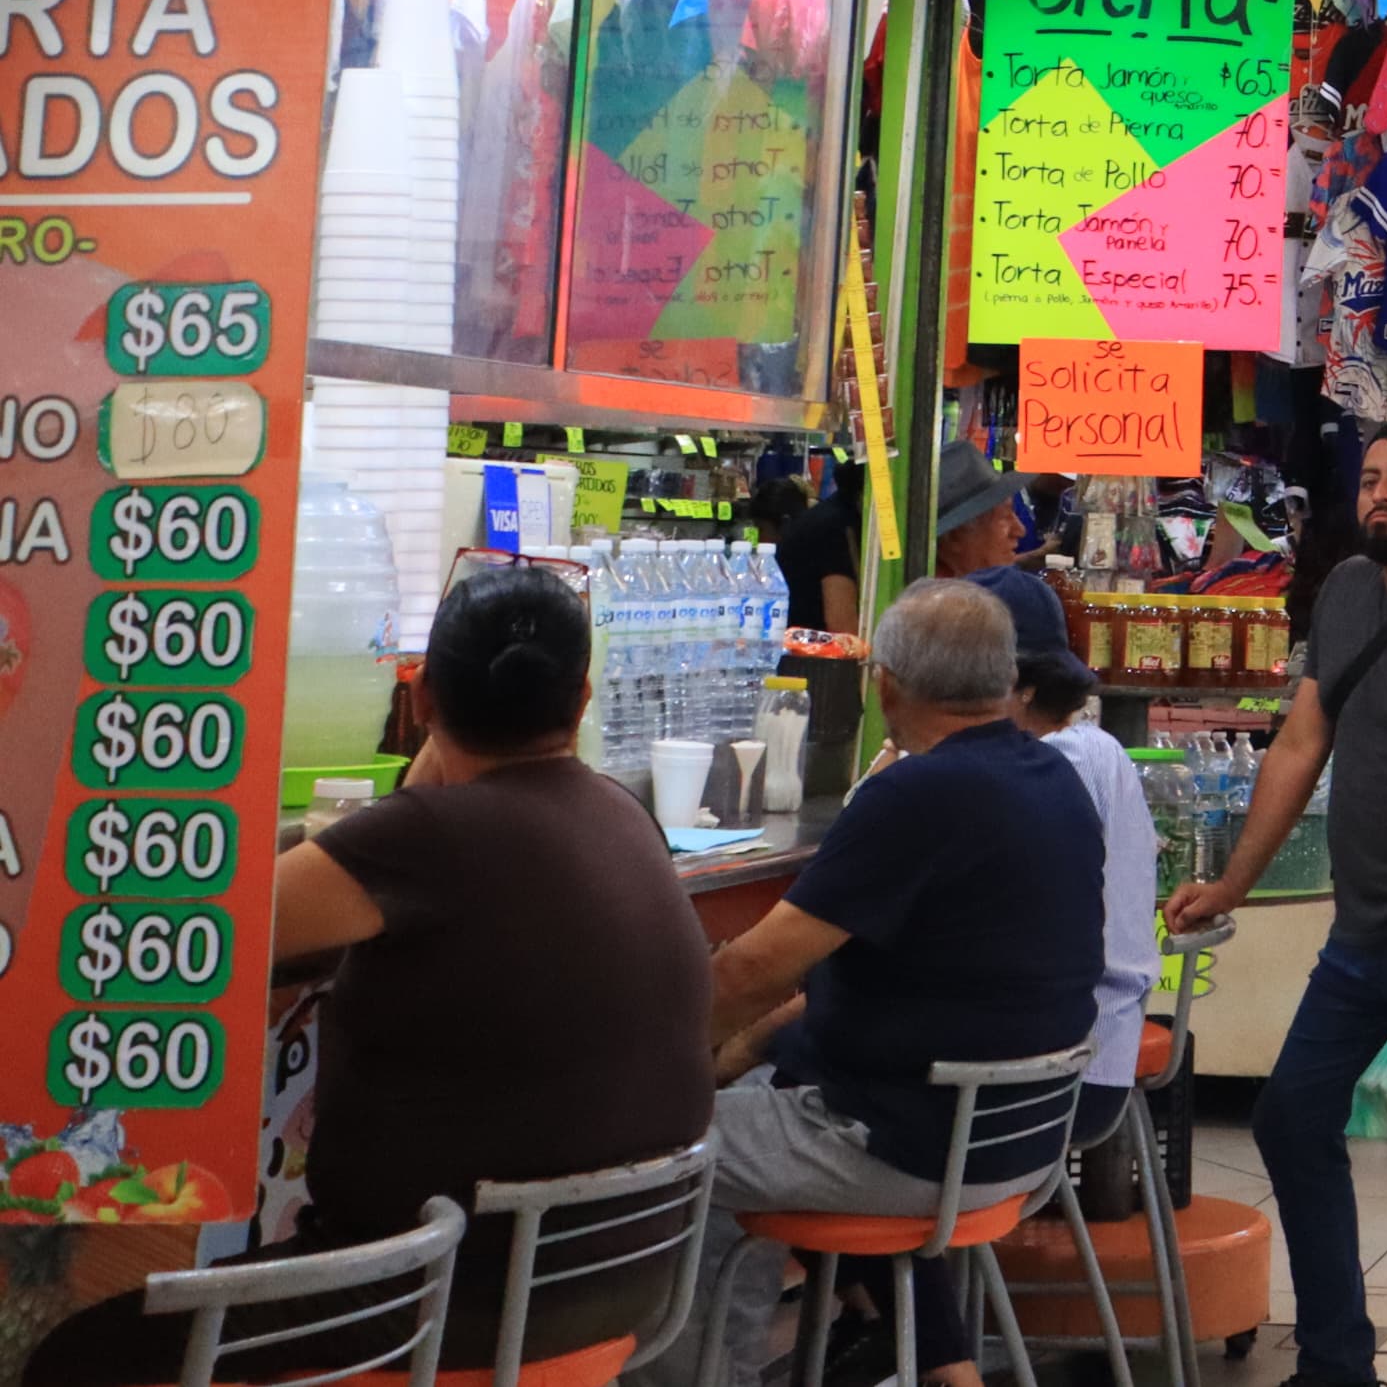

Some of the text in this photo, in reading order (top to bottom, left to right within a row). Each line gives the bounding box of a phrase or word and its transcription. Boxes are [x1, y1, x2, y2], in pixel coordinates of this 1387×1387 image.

[1004, 52, 1085, 88] Torta
[1099, 63, 1177, 90] Jamón
[0, 72, 279, 179] DOS
[999, 108, 1069, 138] Torta
[1079, 115, 1100, 134] de
[1108, 111, 1184, 141] Pierna
[995, 152, 1064, 187] Torta
[1073, 164, 1094, 182] de
[1104, 159, 1166, 190] Pollo
[993, 201, 1061, 234] Torta
[991, 254, 1061, 285] Torta
[1082, 259, 1187, 293] Especial
[121, 287, 259, 373] $65
[1023, 399, 1184, 454] Personal
[108, 487, 249, 574] $60
[490, 510, 518, 532] VISA
[104, 593, 244, 680] $60
[91, 694, 233, 782] $60
[83, 802, 227, 891] $60
[76, 906, 221, 997] $60
[65, 1013, 211, 1104] $60
